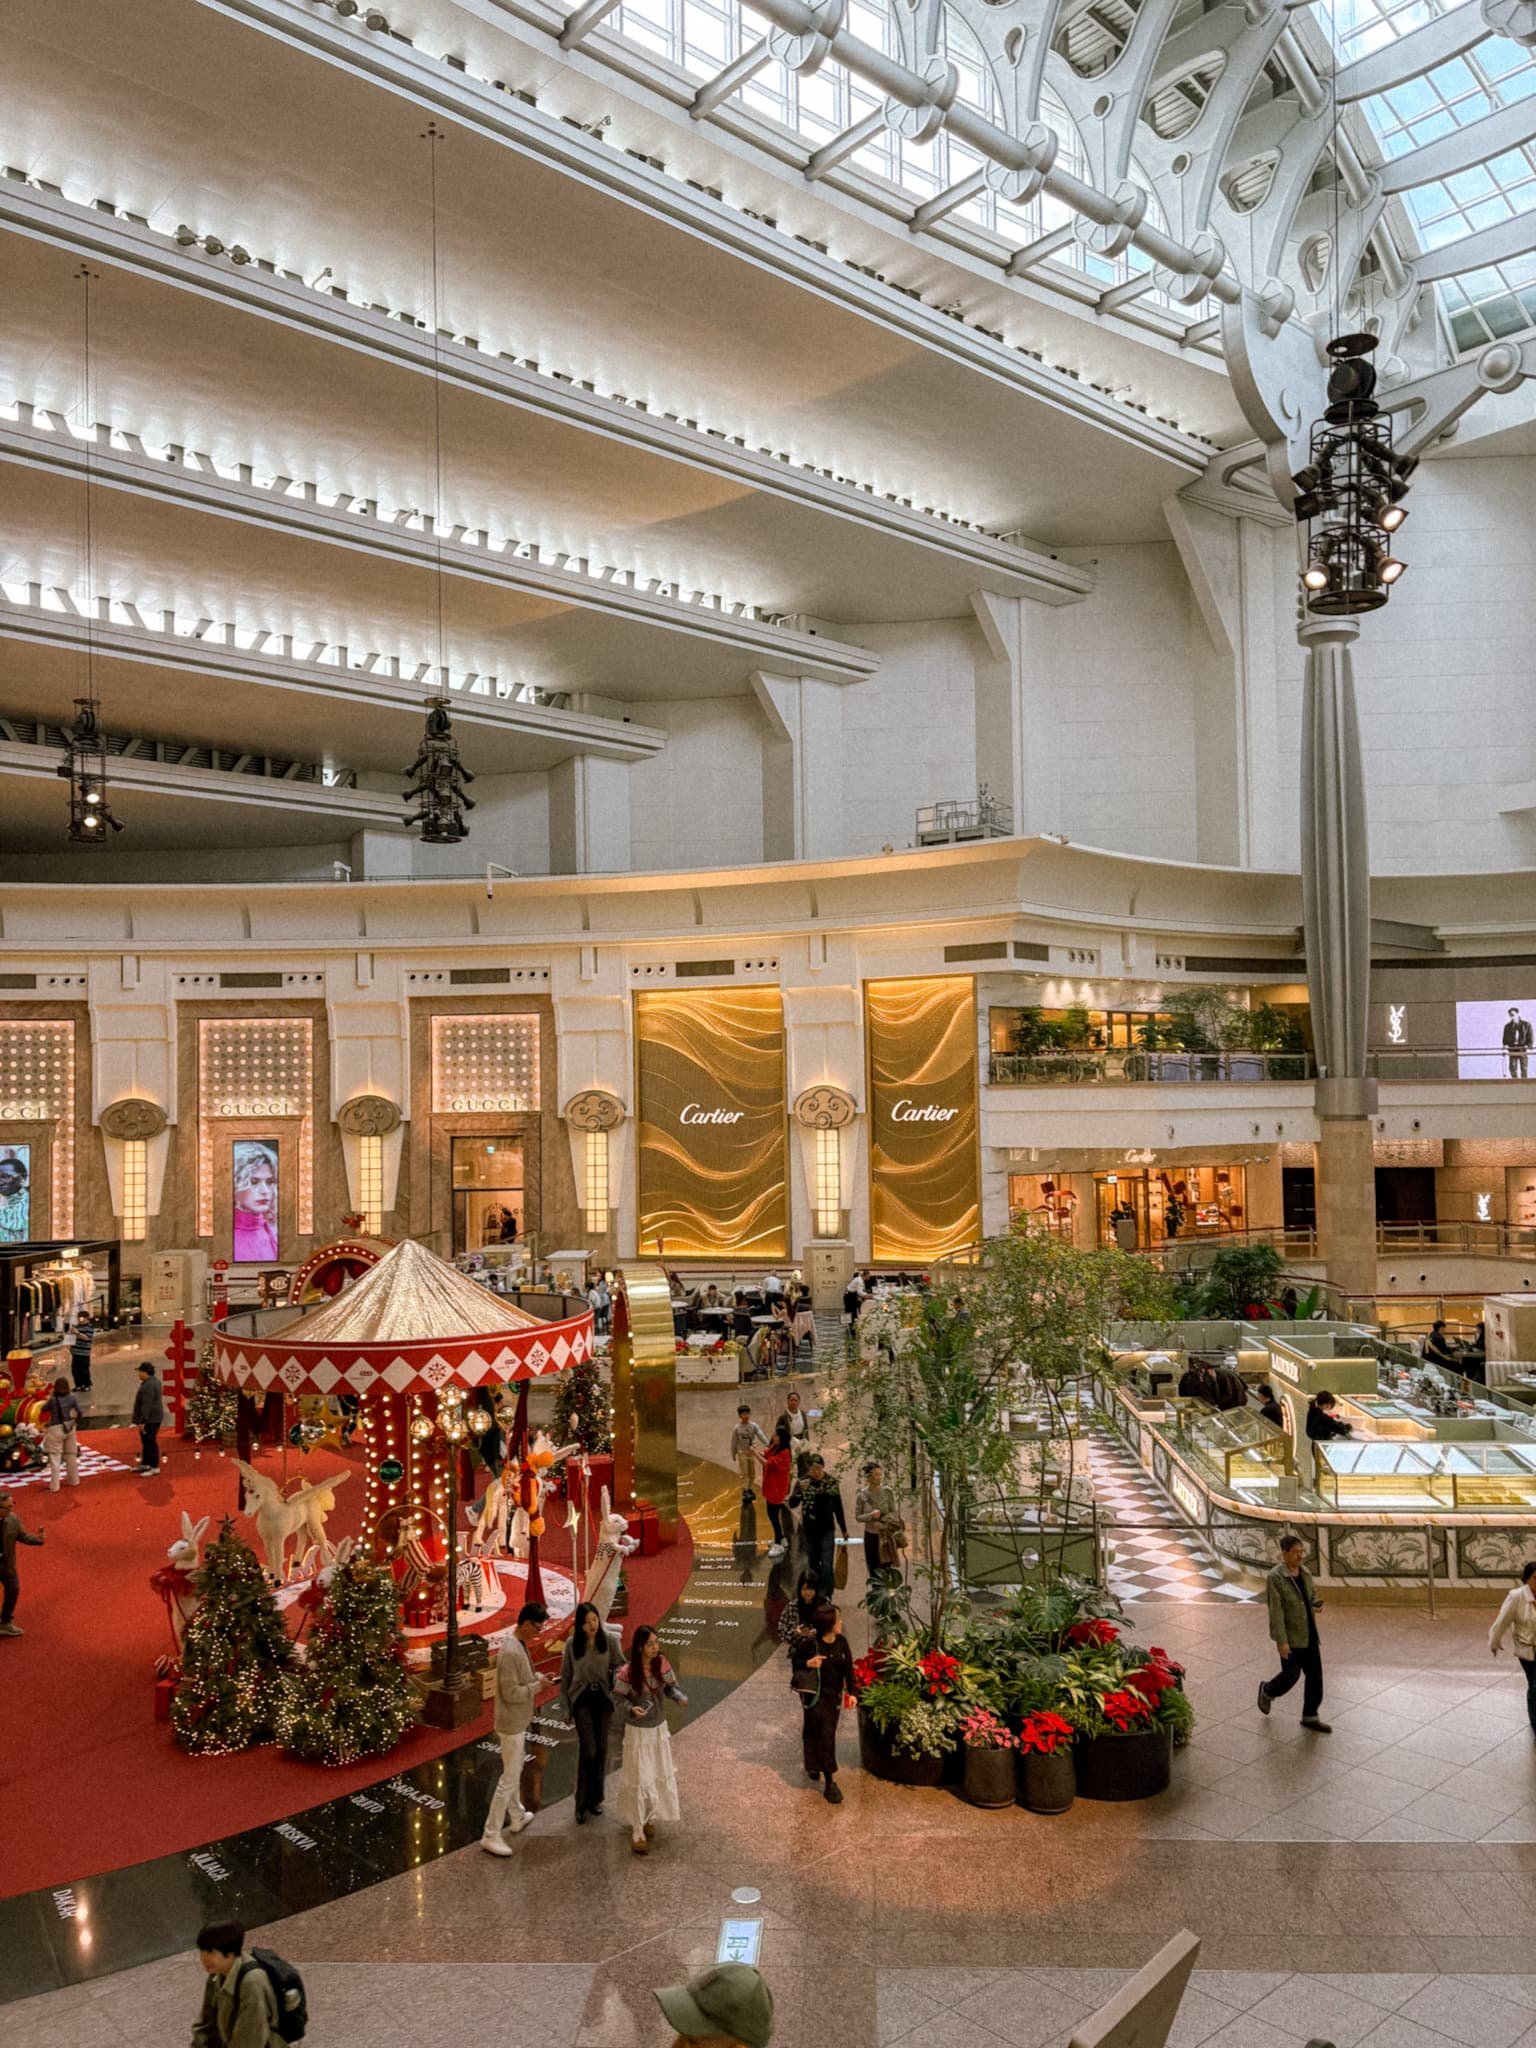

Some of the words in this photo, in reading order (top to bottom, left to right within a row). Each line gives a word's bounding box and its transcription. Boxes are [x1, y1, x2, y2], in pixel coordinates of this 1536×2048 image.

[220, 1103, 291, 1115] GUCCI
[451, 1099, 519, 1112] GUCCI
[679, 1103, 745, 1125] Cartier
[890, 1099, 959, 1122] Cartier
[683, 1599, 753, 1607] MONTEVIDEO
[668, 1617, 707, 1625] SANTA
[715, 1620, 740, 1628] ANA
[351, 1794, 386, 1814] QUITO
[387, 1780, 446, 1811] SARAJEVO
[272, 1823, 318, 1851] MOSKVA
[52, 1888, 78, 1920] DAKAR
